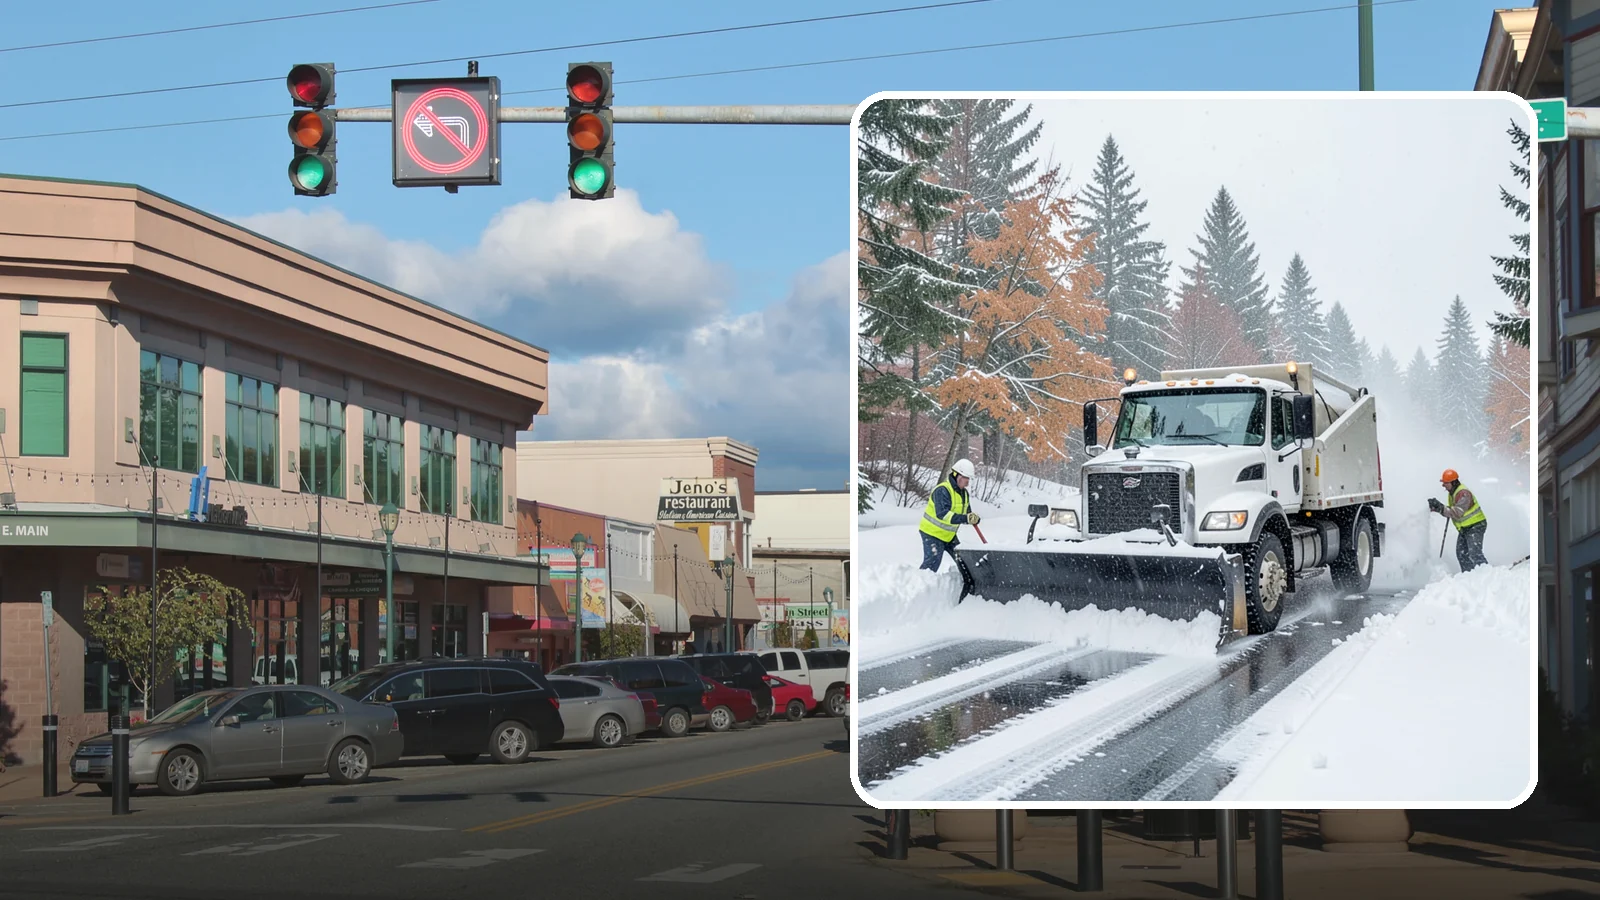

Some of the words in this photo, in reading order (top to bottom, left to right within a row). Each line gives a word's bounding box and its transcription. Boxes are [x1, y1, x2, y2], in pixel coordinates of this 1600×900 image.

[669, 480, 727, 495] Jeno's
[665, 496, 731, 509] restaurant
[658, 510, 681, 520] Italian
[686, 510, 714, 520] American
[715, 509, 738, 520] Cuisine
[2, 525, 13, 536] E.
[15, 525, 49, 536] MAIN
[797, 607, 828, 617] Street
[790, 619, 824, 627] lass
